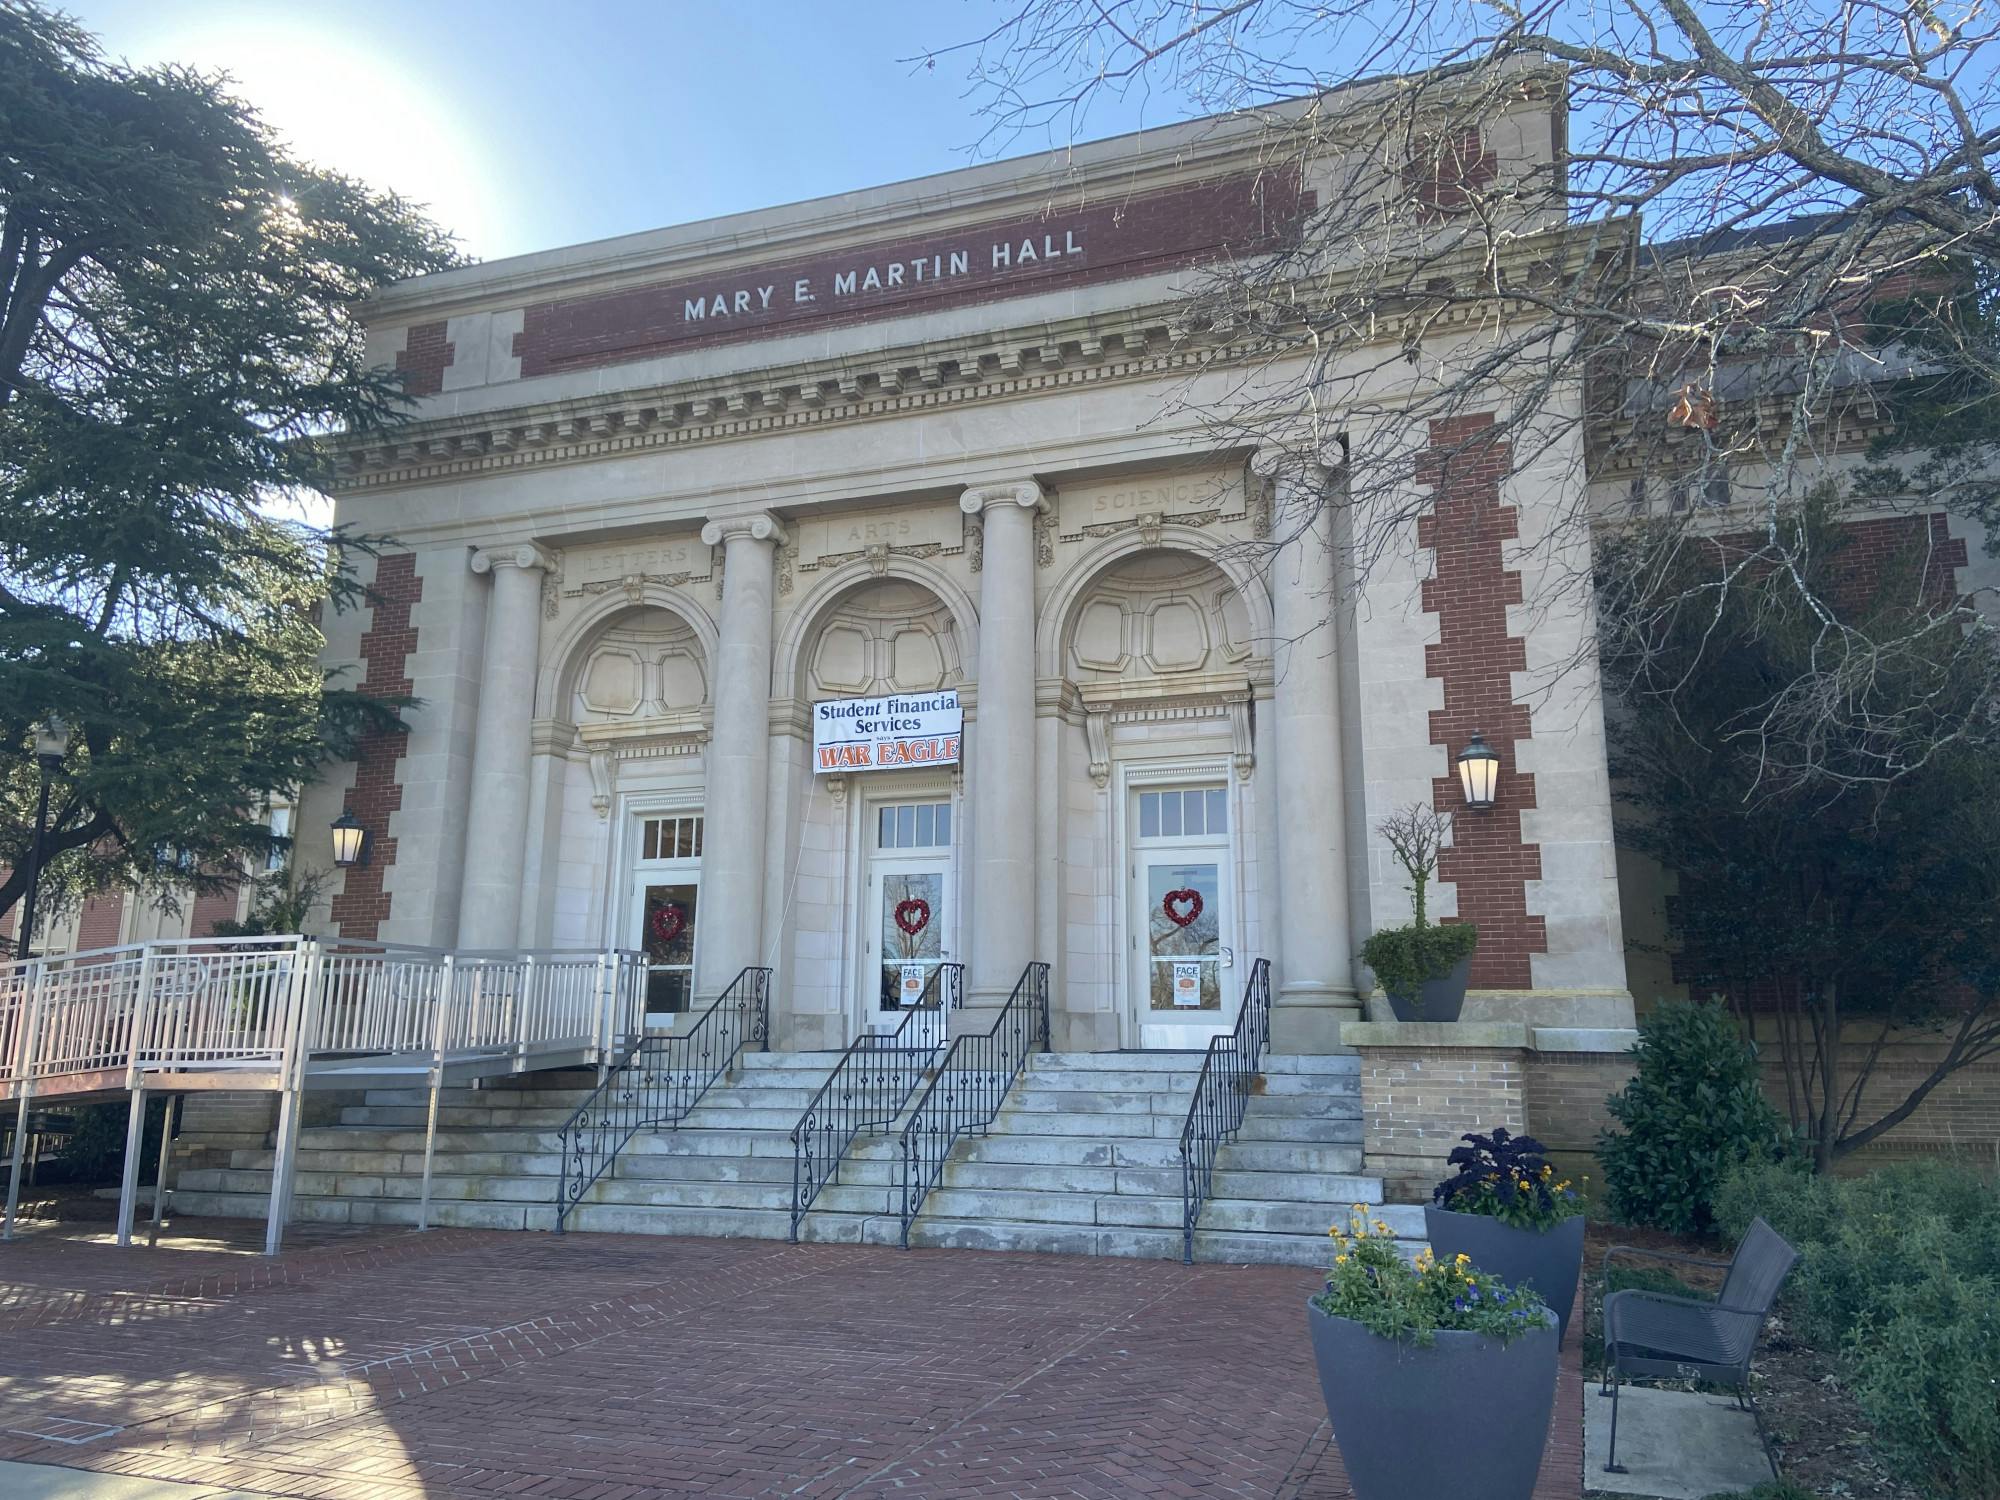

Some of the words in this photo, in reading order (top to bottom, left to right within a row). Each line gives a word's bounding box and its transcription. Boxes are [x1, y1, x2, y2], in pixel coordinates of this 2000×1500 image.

[684, 285, 774, 321] MARY
[795, 279, 815, 302] E.
[834, 250, 968, 296] MARTIN
[992, 231, 1082, 268] HALL
[1094, 482, 1210, 511] SCIENCE
[849, 519, 911, 541] ARTS
[587, 547, 687, 572] LETTERS
[820, 702, 881, 720] Student
[855, 717, 921, 734] Services
[818, 743, 872, 769] WAR
[877, 737, 960, 765] EAGLE
[903, 968, 923, 977] FACE
[1176, 966, 1199, 975] FACE
